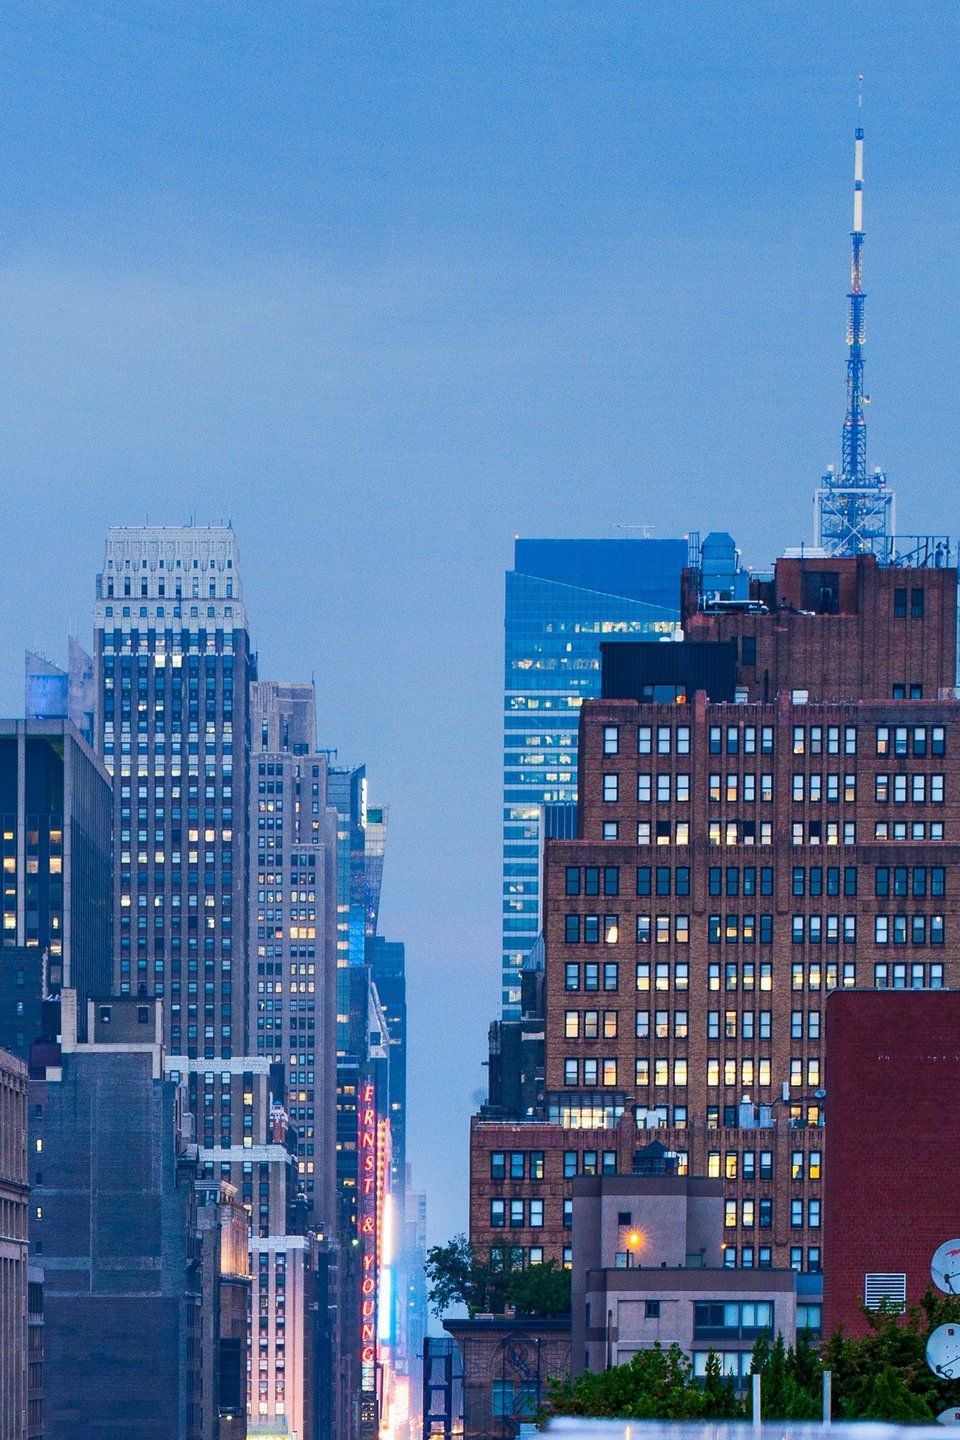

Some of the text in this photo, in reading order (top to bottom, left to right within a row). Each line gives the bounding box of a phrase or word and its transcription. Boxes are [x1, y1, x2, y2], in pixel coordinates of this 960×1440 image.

[362, 1085, 375, 1363] ERNST & YOUNG
